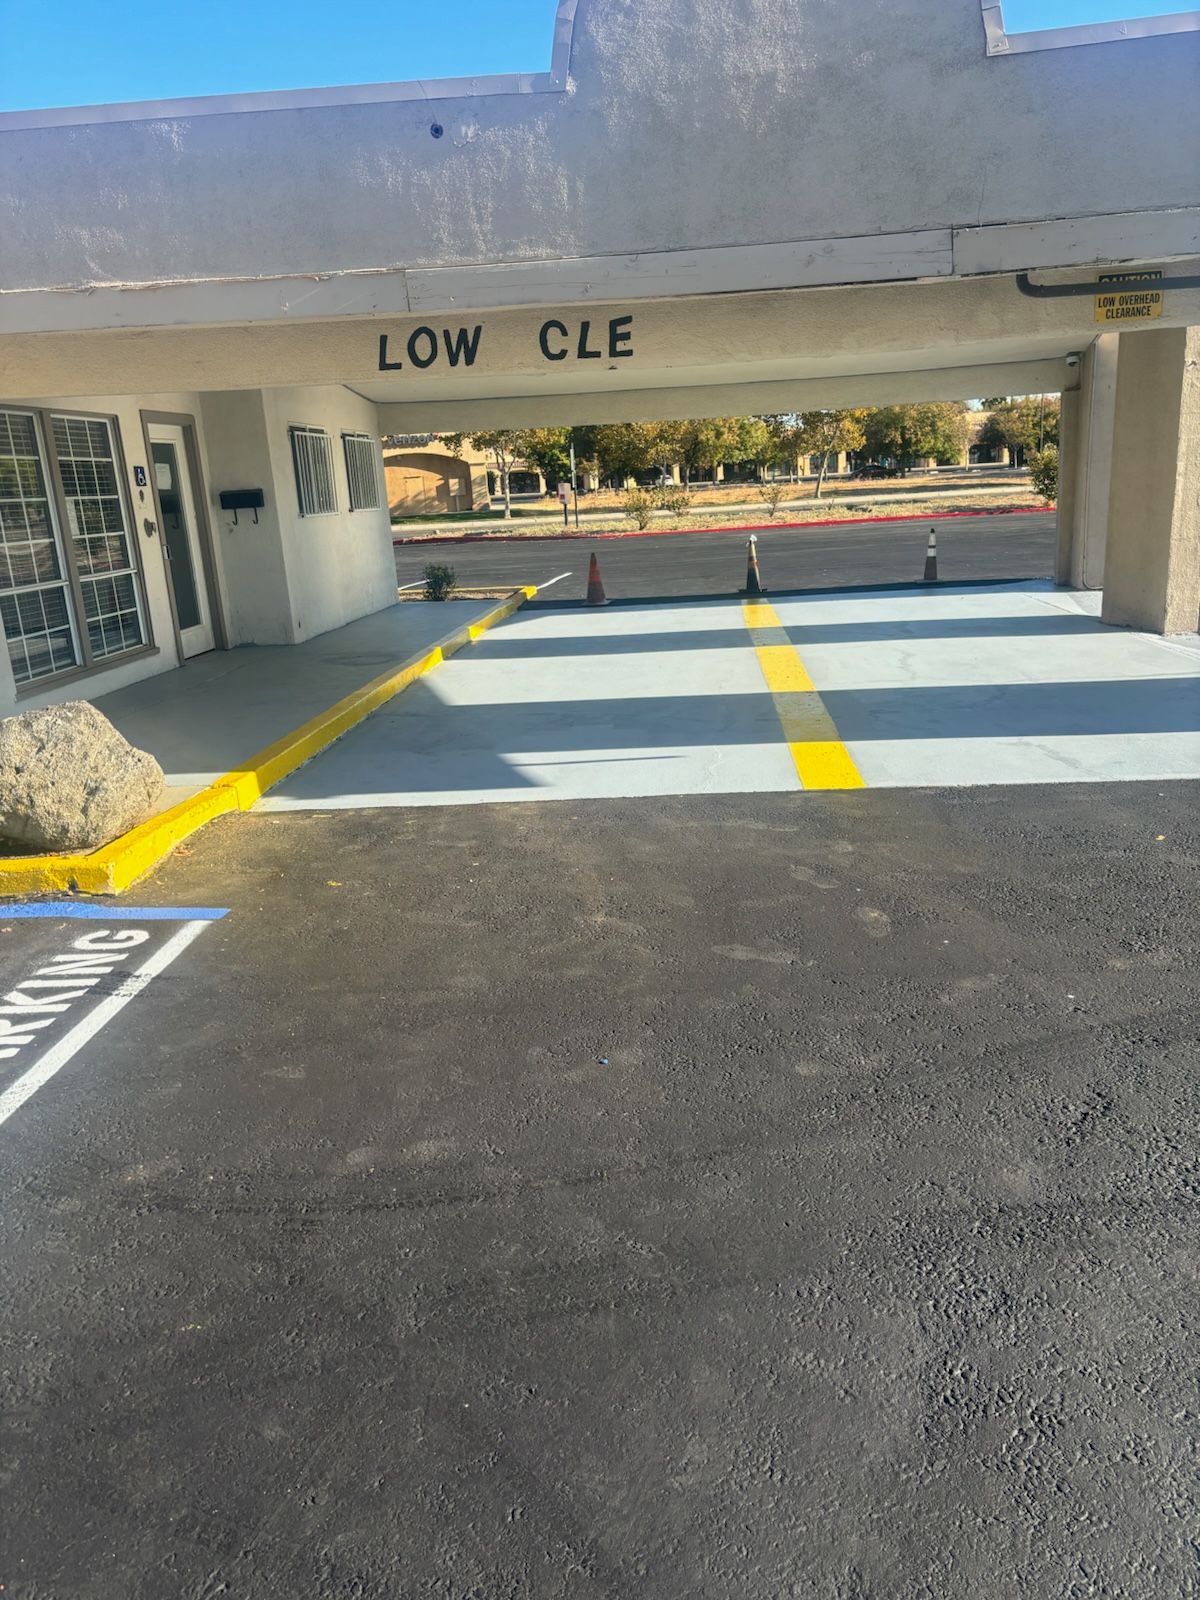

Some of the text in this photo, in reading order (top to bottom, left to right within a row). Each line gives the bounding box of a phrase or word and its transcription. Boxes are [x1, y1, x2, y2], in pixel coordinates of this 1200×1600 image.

[1098, 293, 1160, 308] LOW OVERHEAD
[1105, 306, 1151, 319] CLEARANCE
[379, 315, 634, 371] LOW CLE
[0, 929, 150, 1060] RKING
